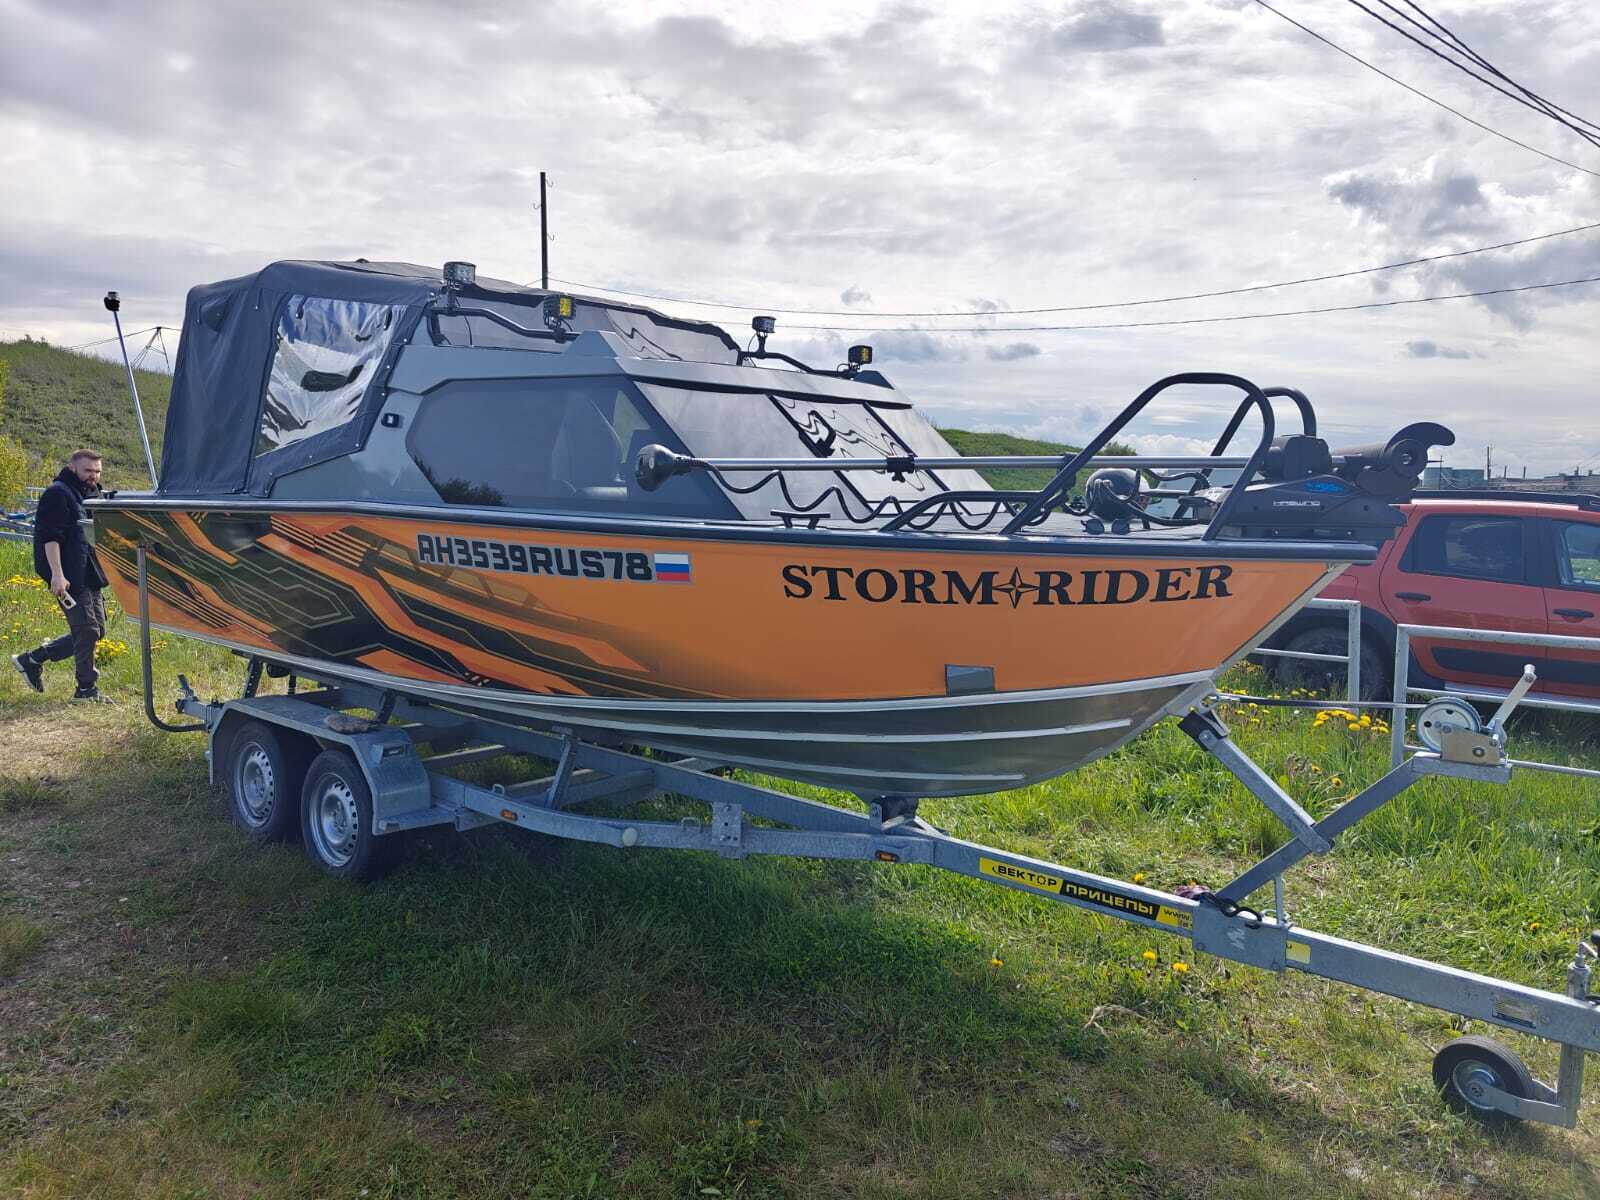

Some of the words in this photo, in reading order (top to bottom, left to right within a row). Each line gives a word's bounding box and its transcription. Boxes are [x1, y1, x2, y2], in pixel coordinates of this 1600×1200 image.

[417, 534, 652, 581] AH3539RUS78
[782, 565, 1000, 605] STORM
[1032, 565, 1233, 605] RIDER
[997, 865, 1057, 886] ВЕКТОР
[1066, 884, 1153, 915] ПРИЦЕПЫ
